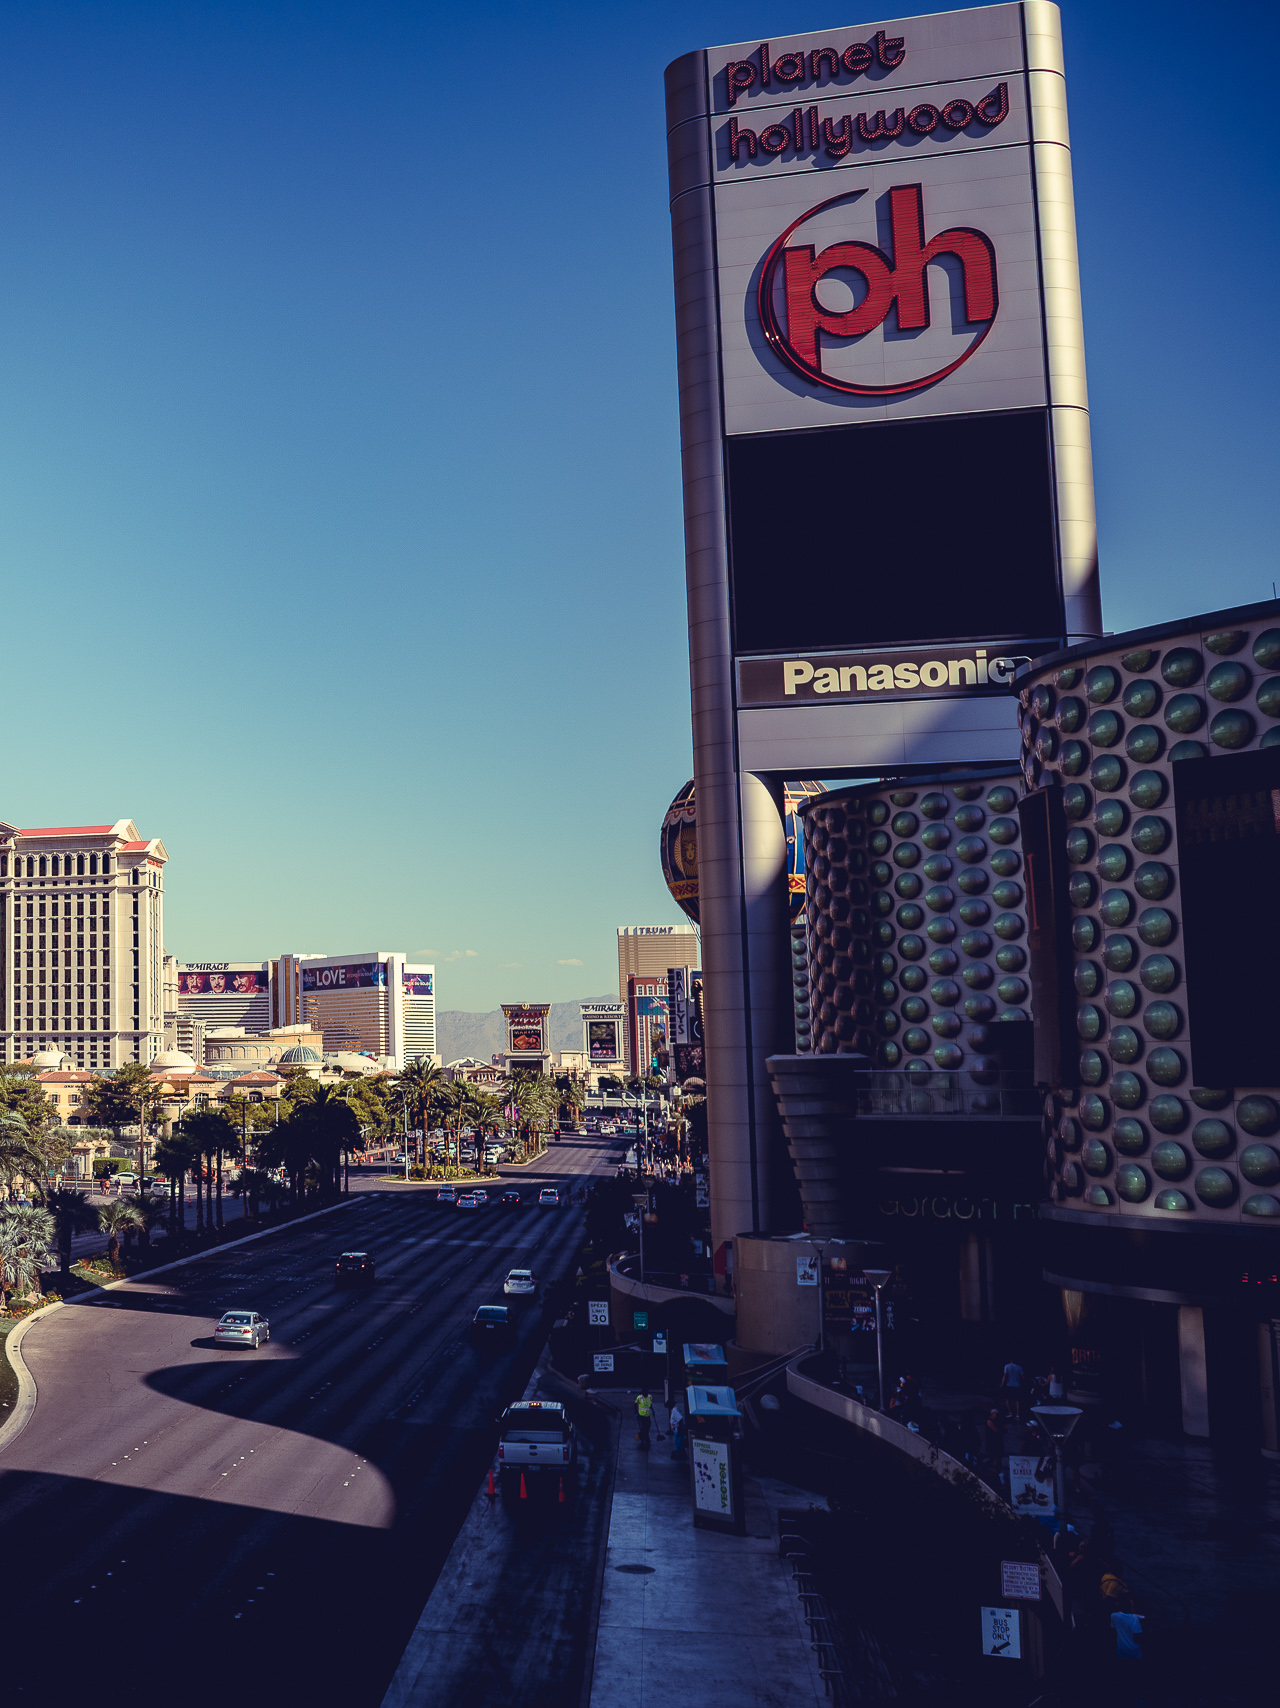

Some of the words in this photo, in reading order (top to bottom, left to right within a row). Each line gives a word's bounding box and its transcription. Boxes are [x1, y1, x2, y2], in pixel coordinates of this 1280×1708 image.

[726, 30, 906, 106] planet
[728, 82, 1010, 160] hollywood
[783, 182, 1000, 374] ph
[783, 649, 1016, 695] Panasonic
[638, 926, 674, 935] TRUMP
[192, 962, 230, 971] MIRAGE
[316, 968, 346, 986] LOVE
[588, 1004, 622, 1012] MIRAGE
[592, 1314, 607, 1323] 30
[694, 1441, 711, 1450] EXPRESS
[700, 1447, 719, 1456] YOURSELF
[719, 1462, 728, 1509] VECTOR
[992, 1633, 1011, 1641] ONLY
